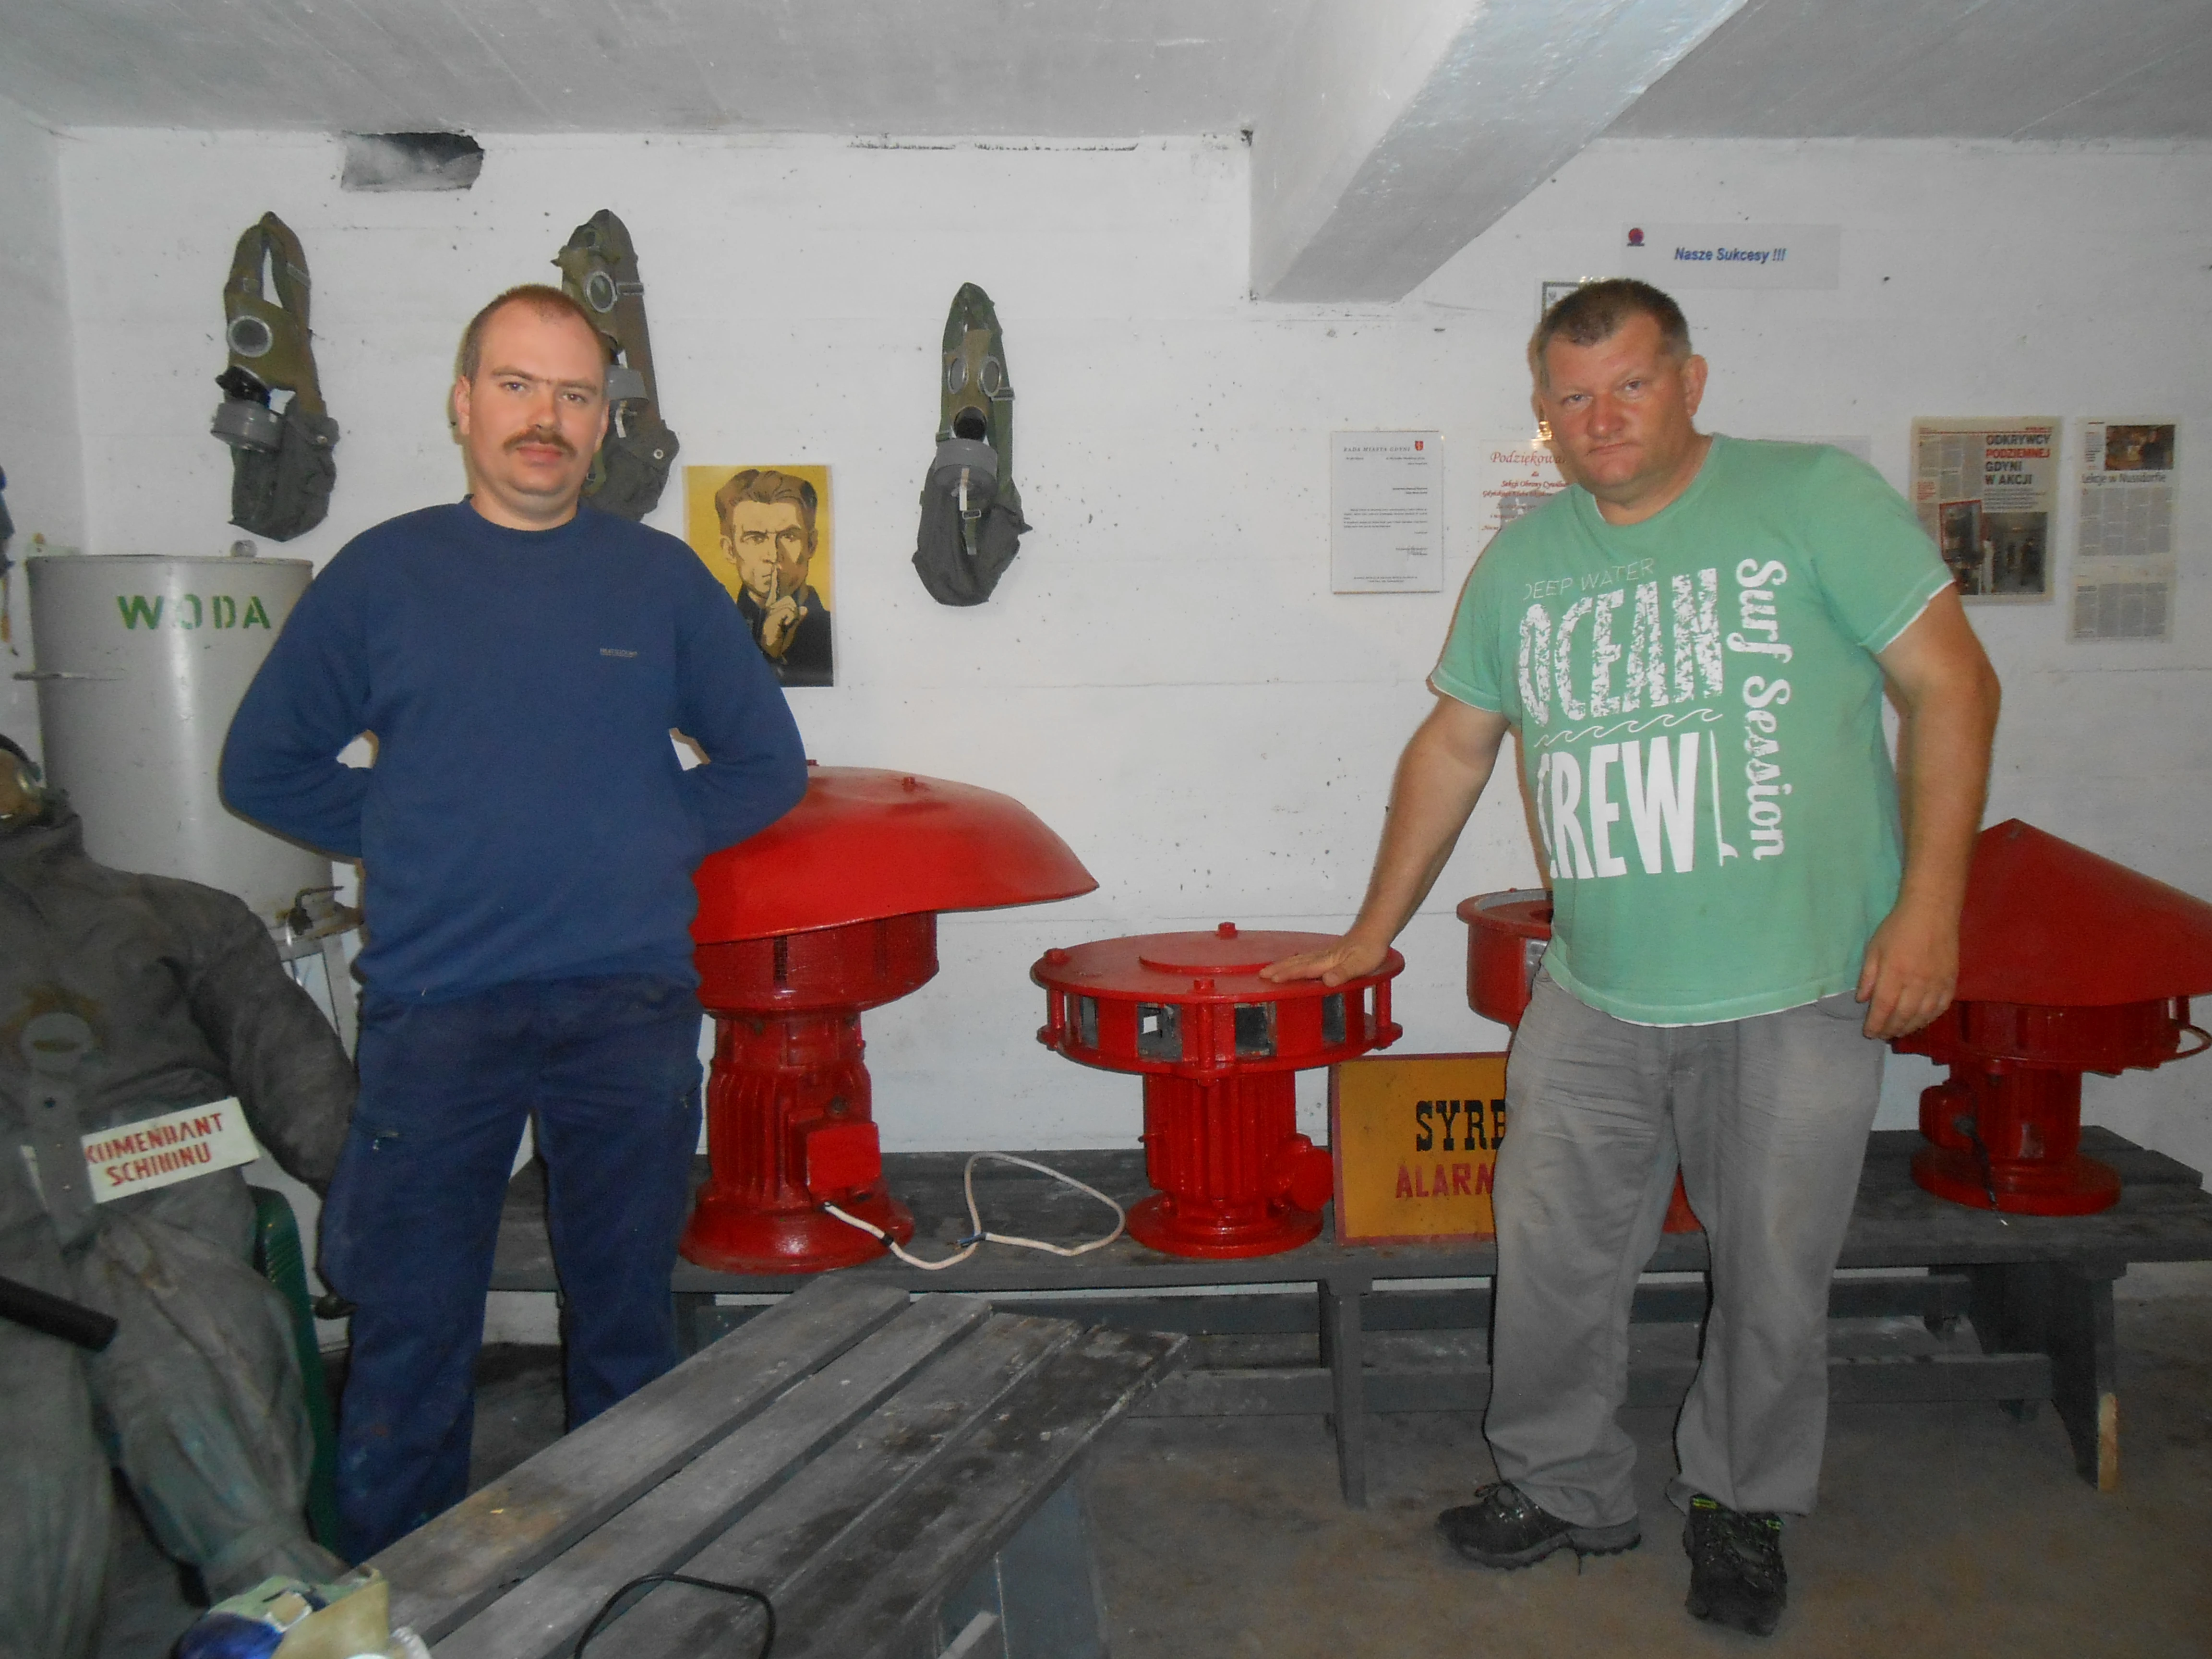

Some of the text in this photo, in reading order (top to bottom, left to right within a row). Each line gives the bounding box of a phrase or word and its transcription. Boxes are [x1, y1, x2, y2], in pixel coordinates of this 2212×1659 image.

[1674, 247, 1713, 261] Nasze
[1716, 247, 1770, 264] Sukcesy
[1986, 434, 2051, 445] ODKRYWCY
[1986, 448, 2050, 458] PODZIEMNEJ
[1985, 461, 2022, 472] GDYNI
[1985, 474, 2032, 485] W AKCJI
[1582, 558, 1654, 591] WATER
[117, 593, 271, 630] WODA
[1518, 568, 1723, 727] OCEAN
[1727, 558, 1792, 861] Surf Session
